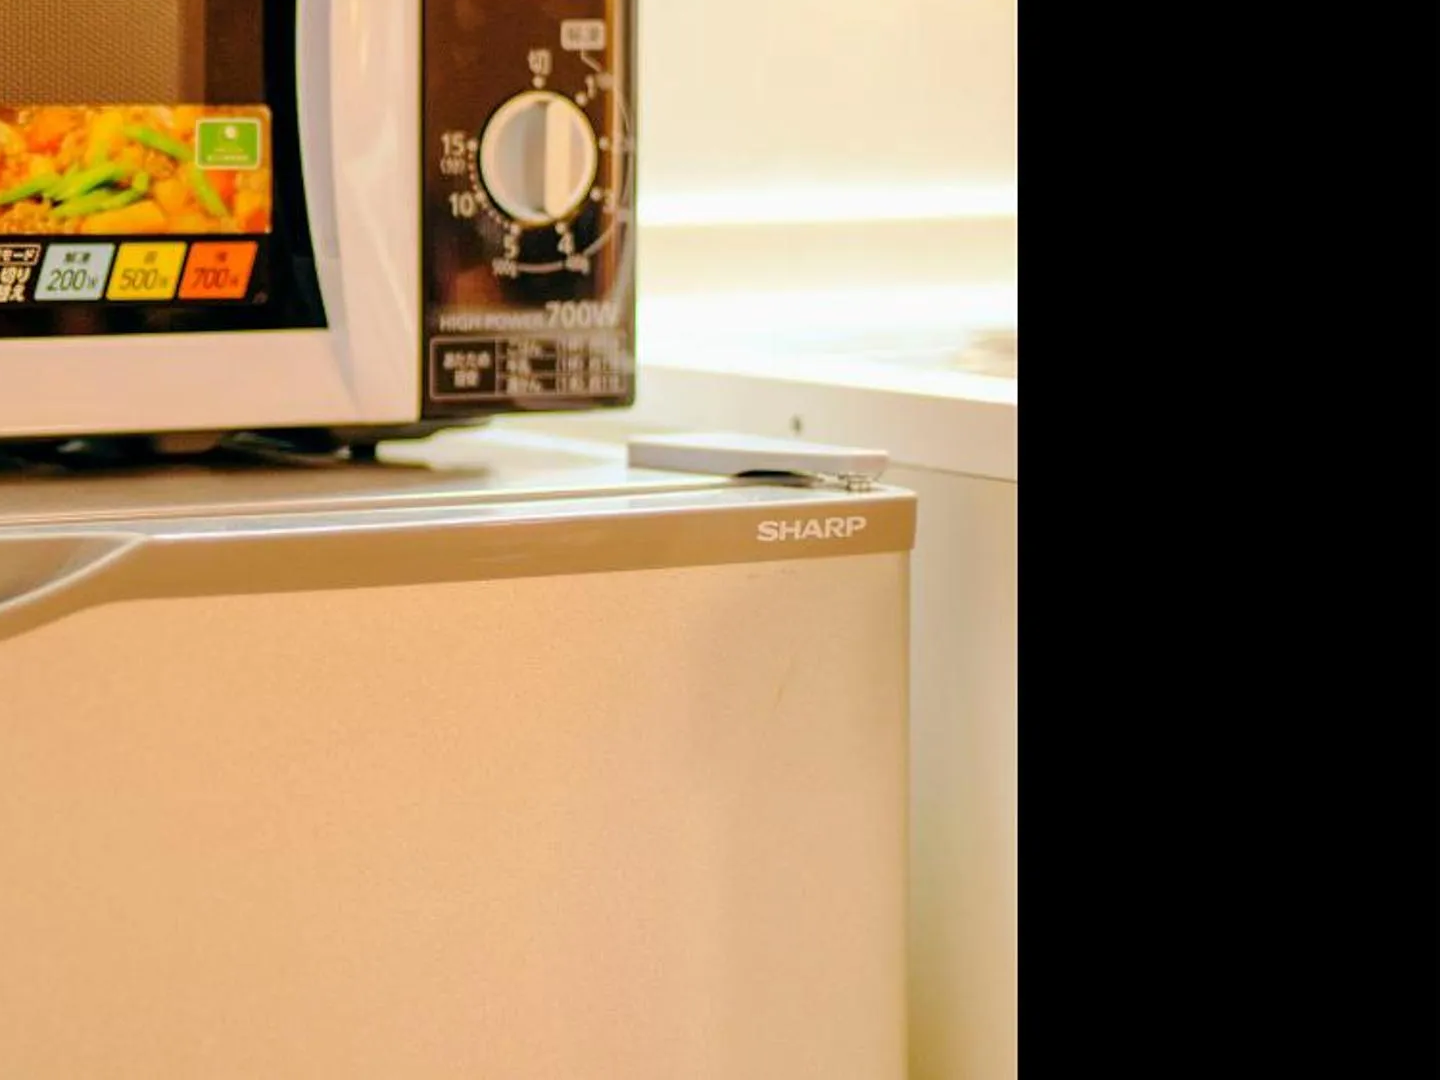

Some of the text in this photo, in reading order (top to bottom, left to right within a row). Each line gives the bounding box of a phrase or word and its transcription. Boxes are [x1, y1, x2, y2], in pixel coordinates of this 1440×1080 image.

[441, 132, 465, 156] 15
[449, 191, 475, 218] 10
[545, 300, 619, 329] 700W
[756, 516, 867, 542] SHARP
